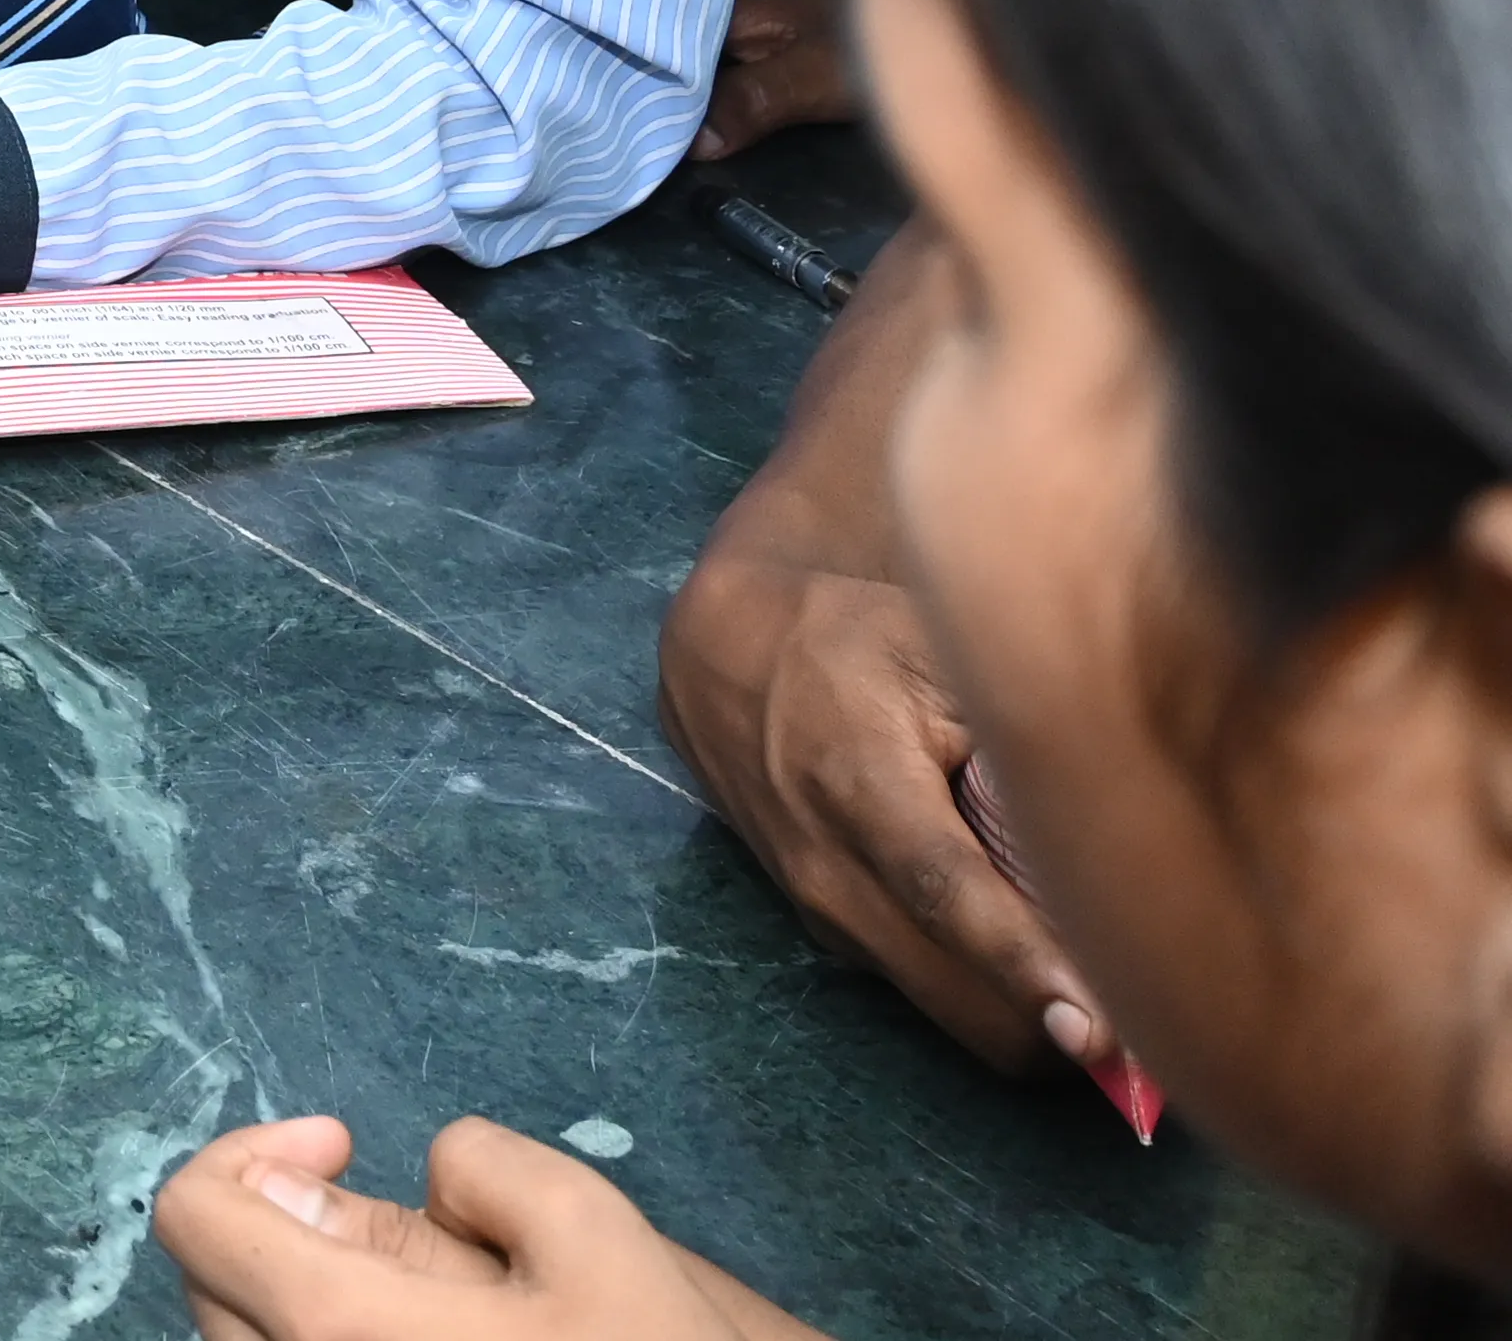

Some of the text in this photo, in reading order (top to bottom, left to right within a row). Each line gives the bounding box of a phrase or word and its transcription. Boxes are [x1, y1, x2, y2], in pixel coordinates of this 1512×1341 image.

[60, 306, 92, 314] inch
[94, 305, 134, 313] (1/64)
[167, 304, 195, 312] 1/20
[157, 314, 192, 322] Easy
[195, 313, 250, 321] reading
[252, 308, 329, 320] graduation
[9, 343, 52, 352] space
[165, 339, 246, 347] correspond
[268, 334, 305, 344] 1/100
[25, 352, 68, 361] space
[94, 349, 124, 357] side
[127, 348, 177, 356] vernier
[181, 347, 262, 356] correspond
[283, 342, 321, 353] 1/100
